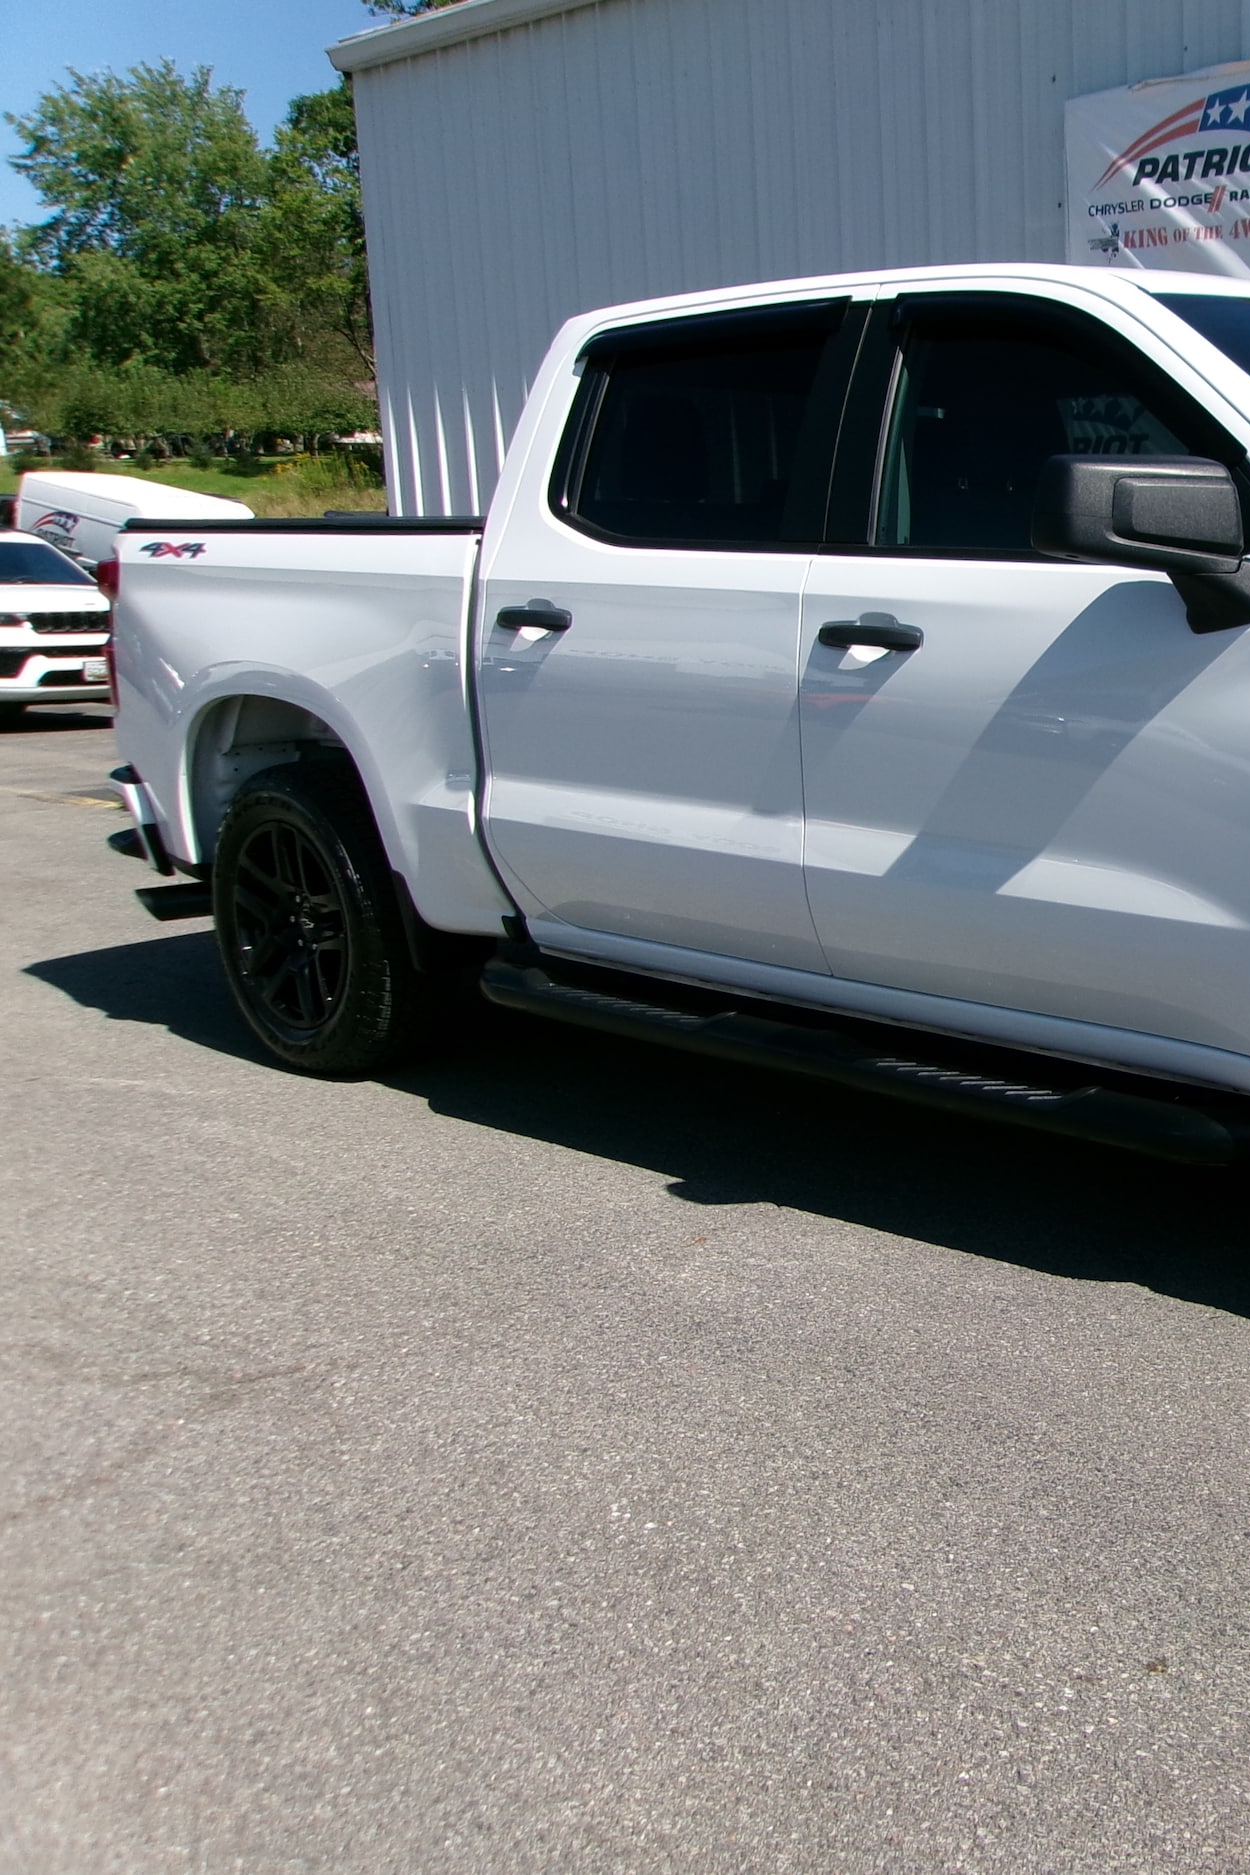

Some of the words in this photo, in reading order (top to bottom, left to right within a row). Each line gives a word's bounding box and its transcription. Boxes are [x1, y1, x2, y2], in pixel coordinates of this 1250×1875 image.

[1088, 200, 1145, 217] CHRYSLER
[1150, 193, 1214, 209] DODGE
[1123, 224, 1168, 249] KING
[1173, 228, 1188, 241] OF
[1194, 226, 1223, 240] THE
